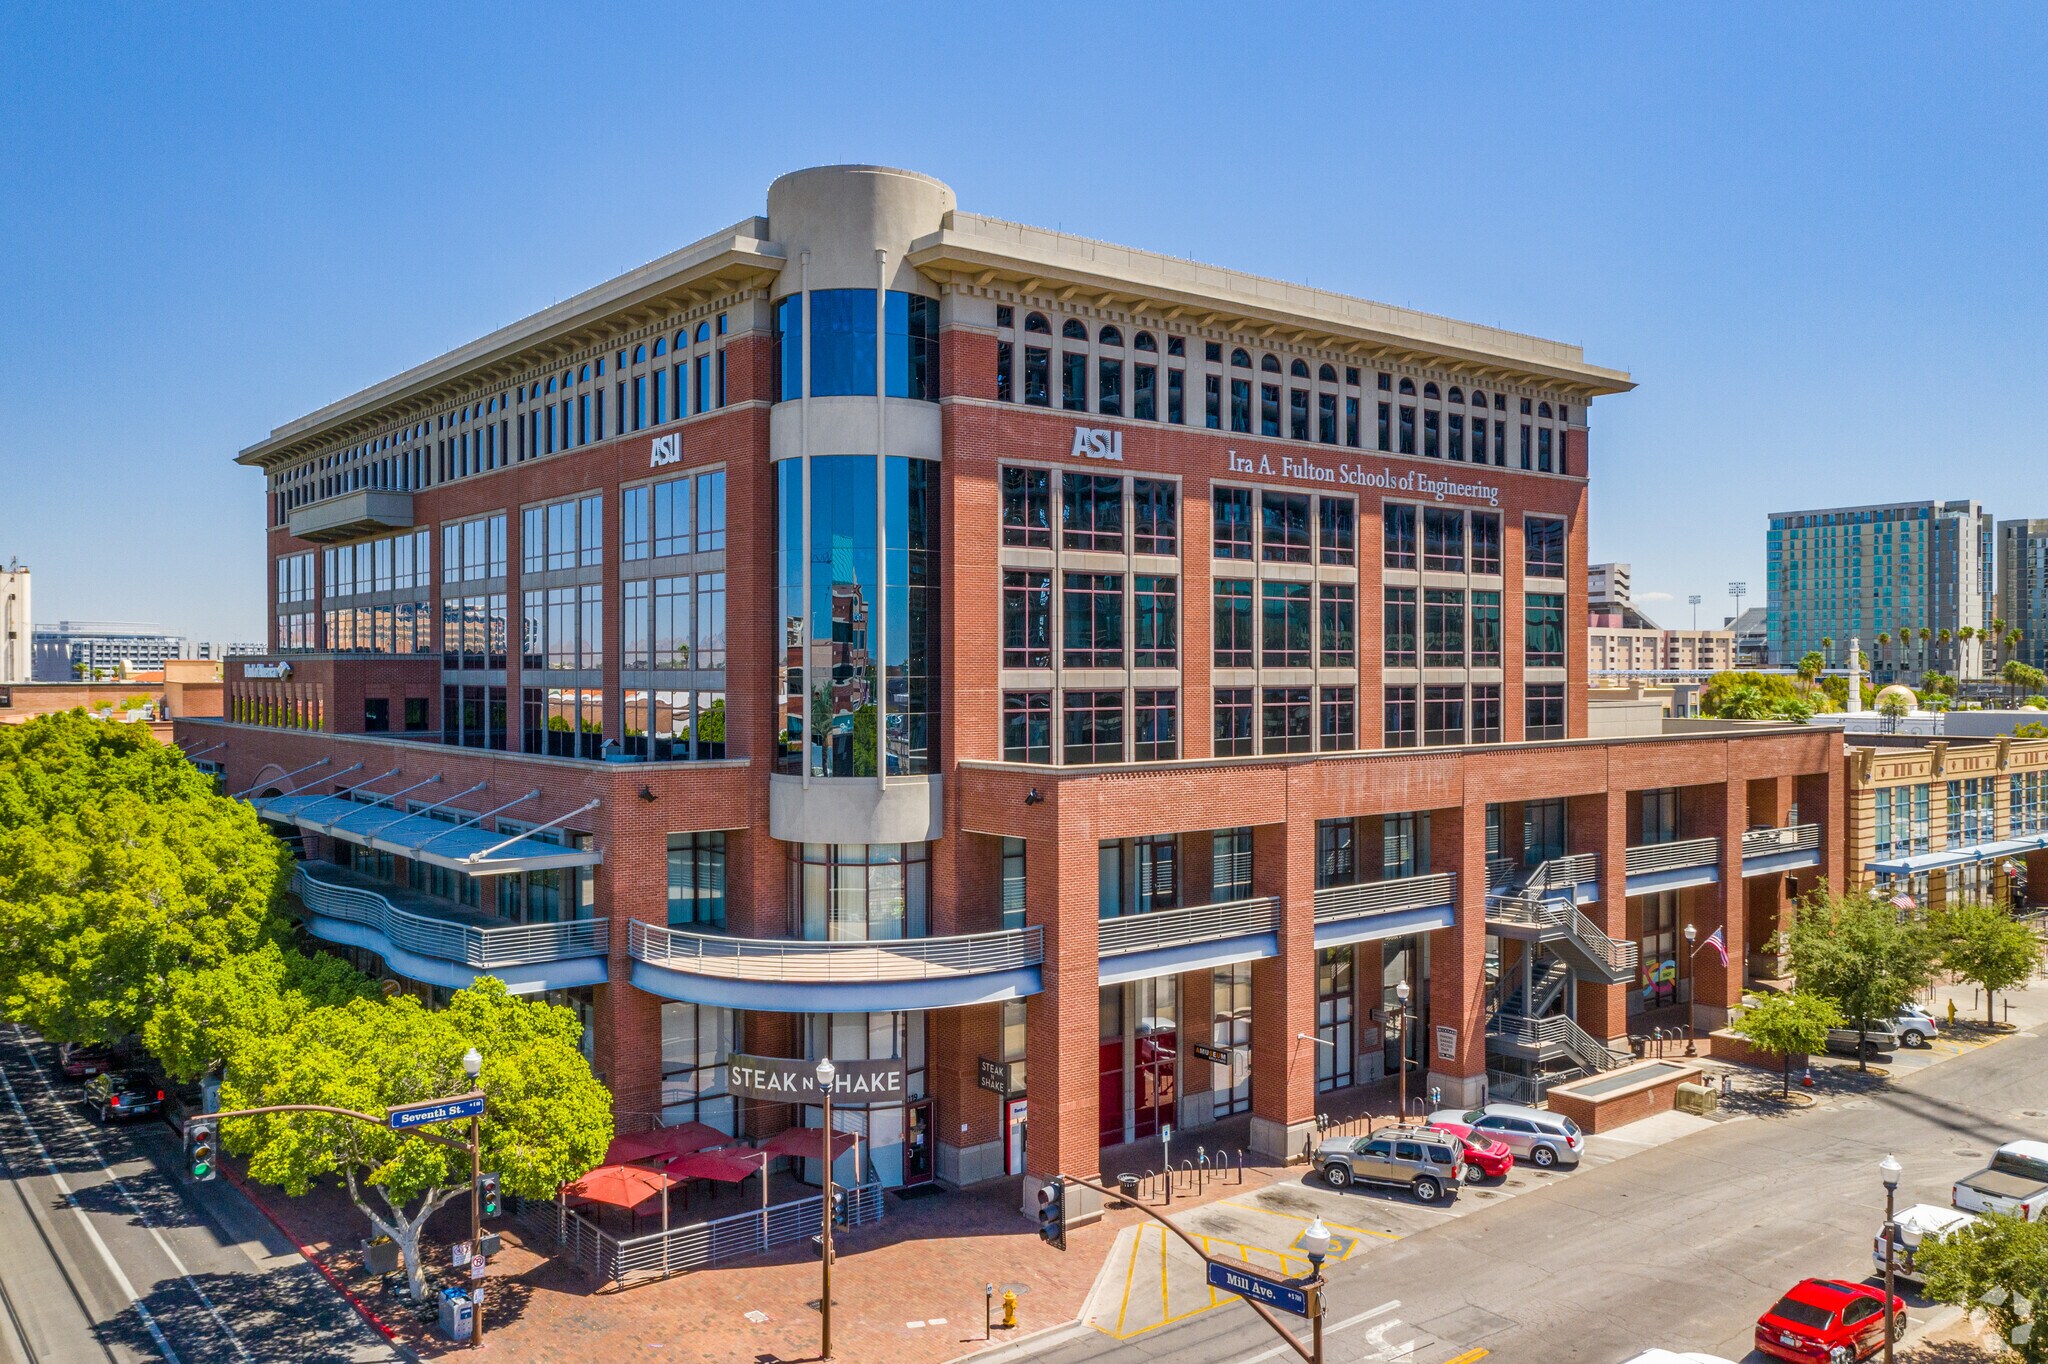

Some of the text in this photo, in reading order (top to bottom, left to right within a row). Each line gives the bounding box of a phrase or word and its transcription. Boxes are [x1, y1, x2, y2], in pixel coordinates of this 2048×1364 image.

[650, 432, 681, 467] ASU
[1071, 426, 1123, 461] ASU
[1229, 450, 1498, 506] Ira A. Fulton Schools of Engineering
[1196, 1047, 1226, 1060] AMUSEUM
[732, 1066, 900, 1093] STEAK N HAKE
[982, 1061, 1004, 1076] STEAK
[981, 1076, 1004, 1092] SHAKE
[908, 1093, 918, 1104] 119
[401, 1105, 464, 1124] Seventh St.
[1226, 1273, 1249, 1290] Mill
[1252, 1282, 1276, 1299] Ave.
